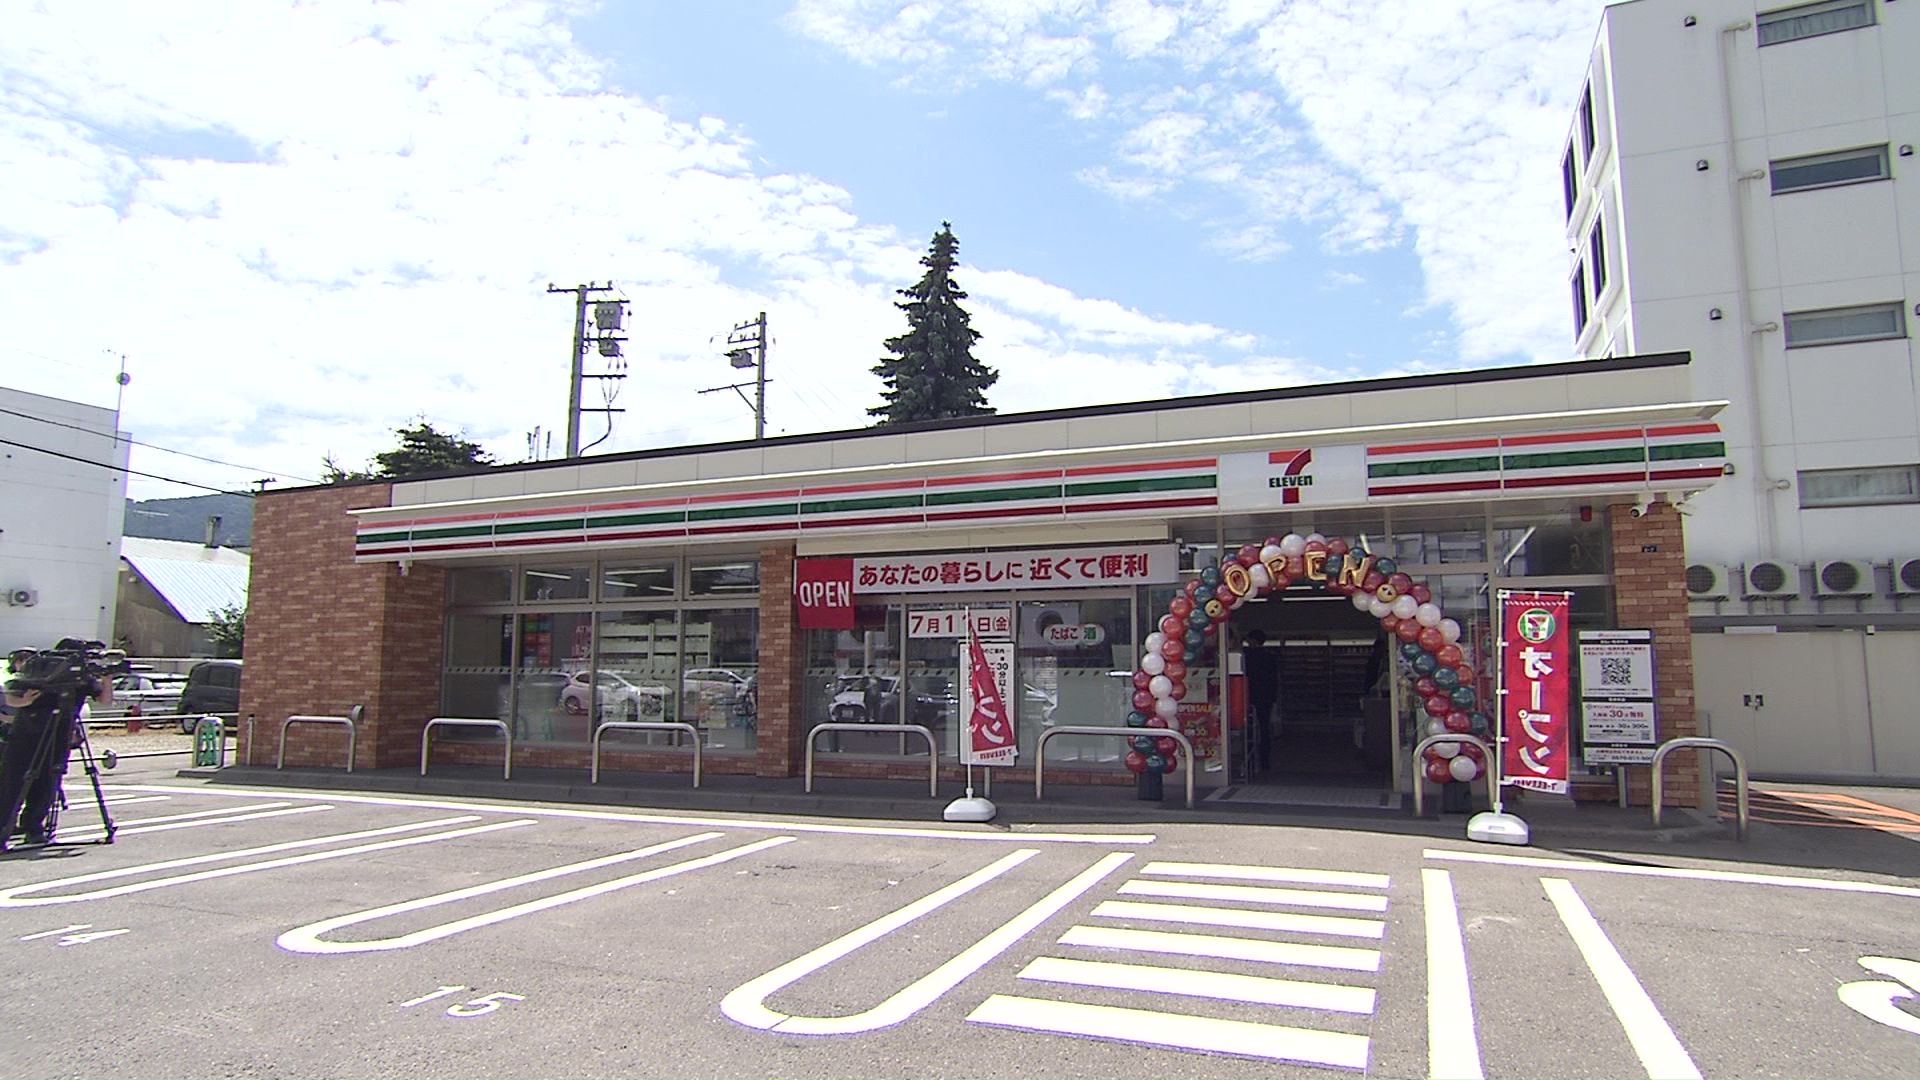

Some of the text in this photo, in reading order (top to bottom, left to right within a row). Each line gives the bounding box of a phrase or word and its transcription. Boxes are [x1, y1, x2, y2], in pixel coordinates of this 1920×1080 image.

[1269, 448, 1312, 504] 7
[1269, 475, 1313, 488] ELEVEn
[859, 553, 1149, 587] あなたの暮らしに 近くて便利
[1224, 551, 1371, 597] OPEN
[799, 580, 851, 608] OPEN
[1050, 627, 1097, 640] たばこ 酒
[20, 924, 130, 946] 14
[400, 984, 526, 1018] 15
